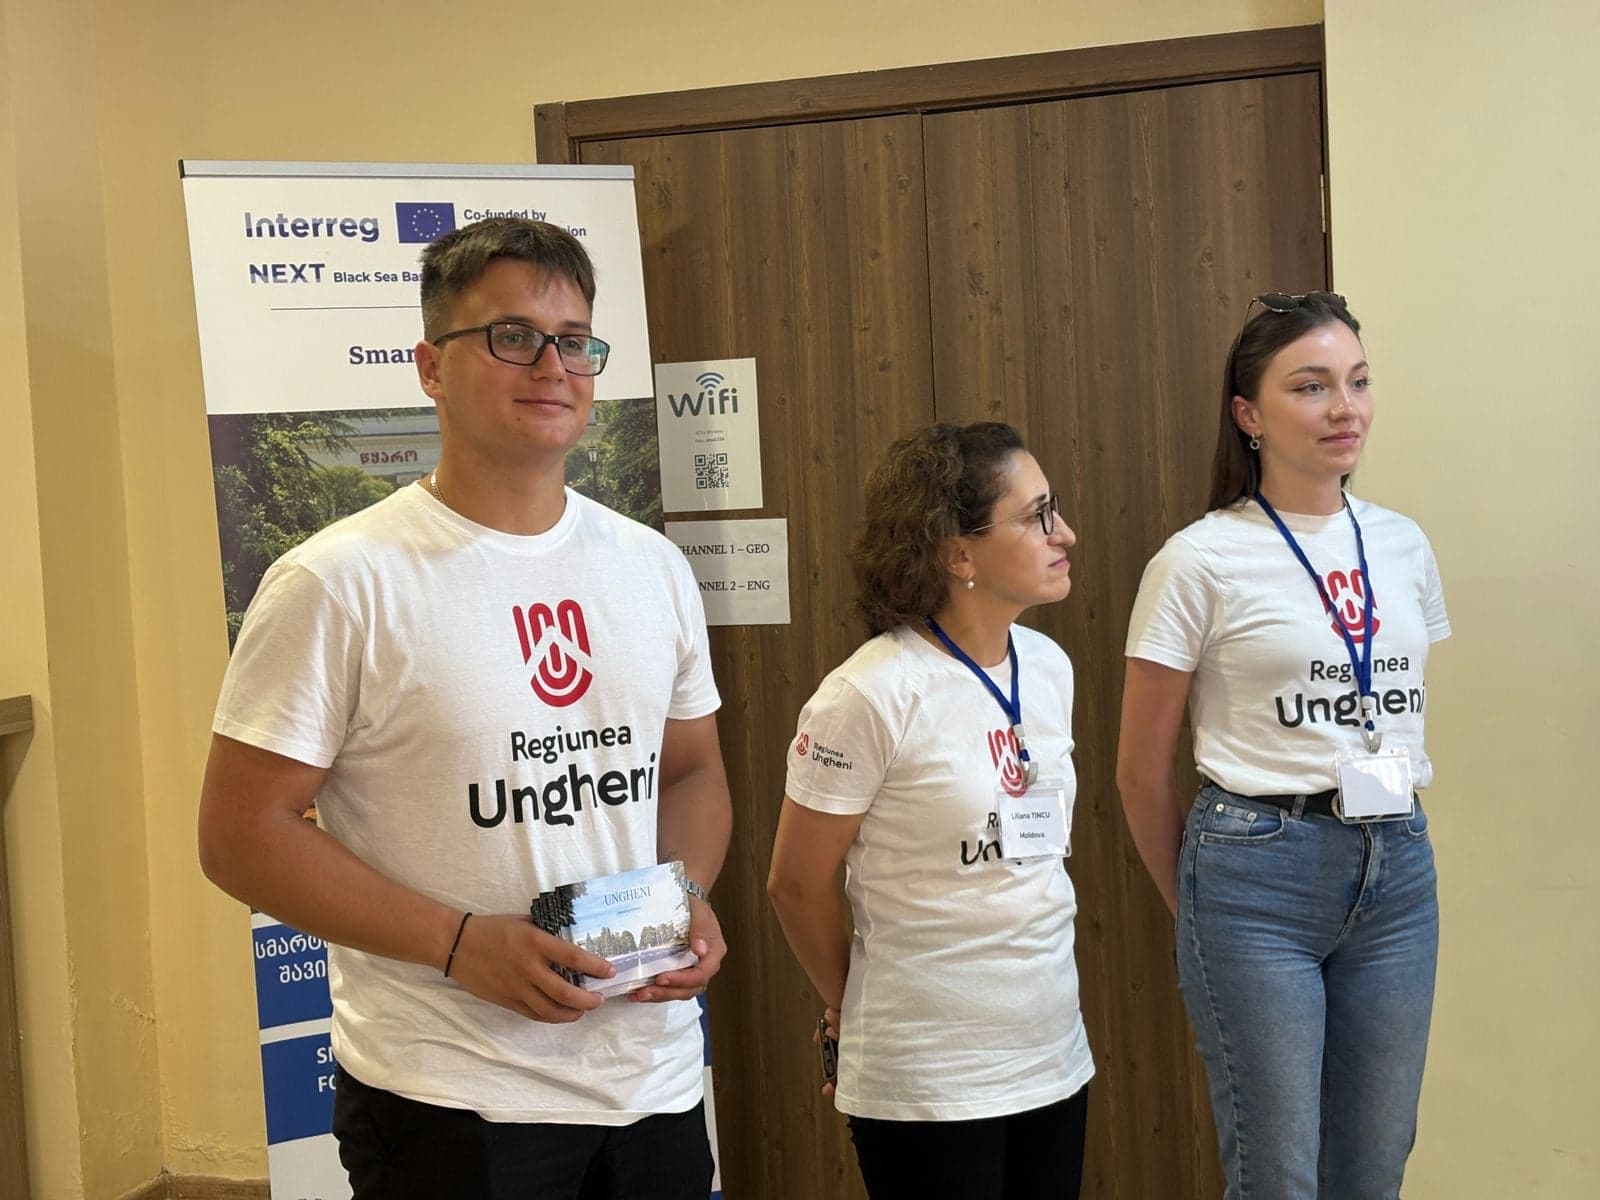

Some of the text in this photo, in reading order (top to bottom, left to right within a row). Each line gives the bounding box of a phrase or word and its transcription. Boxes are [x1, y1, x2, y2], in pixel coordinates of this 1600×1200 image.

[531, 210, 546, 221] by
[244, 212, 379, 243] Interreg
[249, 263, 325, 284] NEXT
[333, 271, 424, 283] Black Sea Bas
[349, 345, 416, 365] Smar
[668, 388, 739, 418] Wifi
[730, 544, 735, 554] 1
[746, 543, 770, 554] GEO
[698, 581, 728, 592] NNEL
[730, 581, 736, 591] 2
[747, 580, 770, 591] ENG
[1310, 656, 1409, 684] Regnea
[511, 725, 632, 764] Regiunea
[813, 742, 844, 758] Regiunea
[812, 751, 853, 770] Ungheni
[468, 751, 656, 829] Ungheni
[603, 886, 651, 906] UNGHENI
[279, 960, 326, 983] შავი
